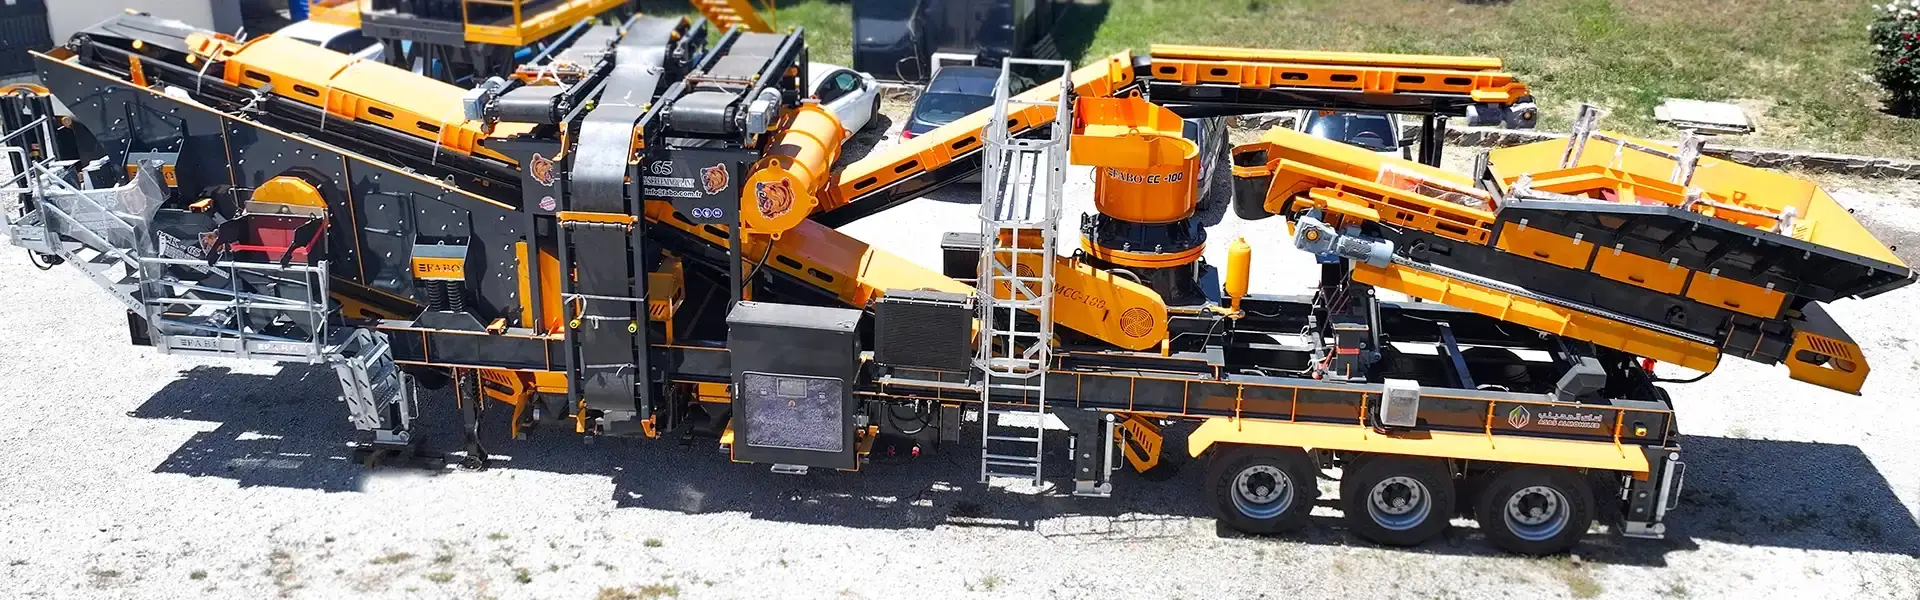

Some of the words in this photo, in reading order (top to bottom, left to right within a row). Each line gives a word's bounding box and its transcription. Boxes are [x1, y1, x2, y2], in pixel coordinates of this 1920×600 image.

[651, 160, 673, 176] 65
[1147, 174, 1161, 184] CC
[421, 263, 461, 272] FABO
[1053, 282, 1107, 310] MCC-100
